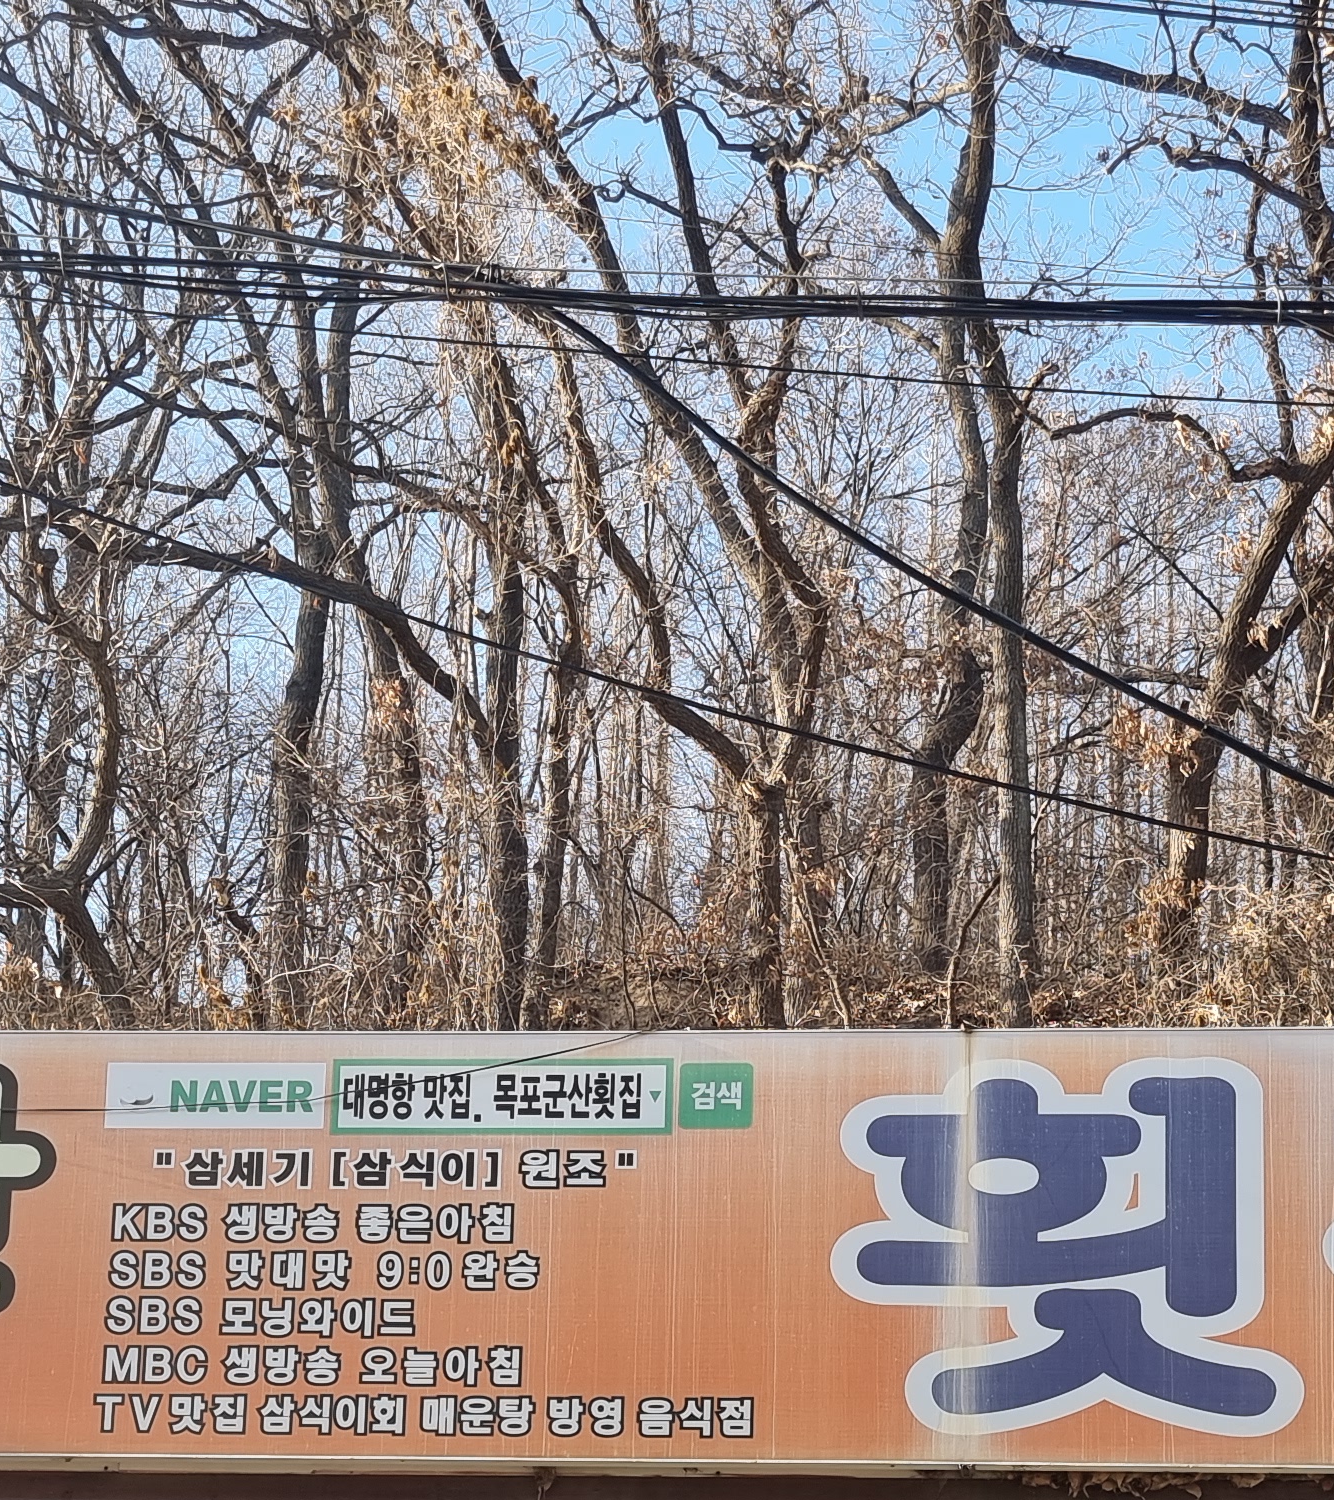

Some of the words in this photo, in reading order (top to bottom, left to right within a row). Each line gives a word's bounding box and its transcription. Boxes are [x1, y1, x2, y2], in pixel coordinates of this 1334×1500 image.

[169, 1080, 314, 1112] NAVER
[342, 1073, 415, 1120] 대명항
[493, 1072, 642, 1120] 목포군산횟집
[691, 1081, 743, 1110] 검색
[111, 1202, 207, 1242] KBS
[221, 1202, 339, 1243] 생방송
[355, 1202, 515, 1244] 좋은아침
[108, 1249, 206, 1289] SBS
[226, 1249, 351, 1290] 맛대맛
[104, 1295, 203, 1335] SBS
[218, 1297, 415, 1338] 모닝와이드
[101, 1345, 208, 1384] MBC
[221, 1345, 342, 1385] 생방송
[359, 1346, 524, 1387] 오늘아침
[257, 1393, 407, 1436] 삼식이회
[419, 1394, 536, 1437] 매운탕
[545, 1396, 624, 1437] 방영
[637, 1396, 755, 1438] 음식점
